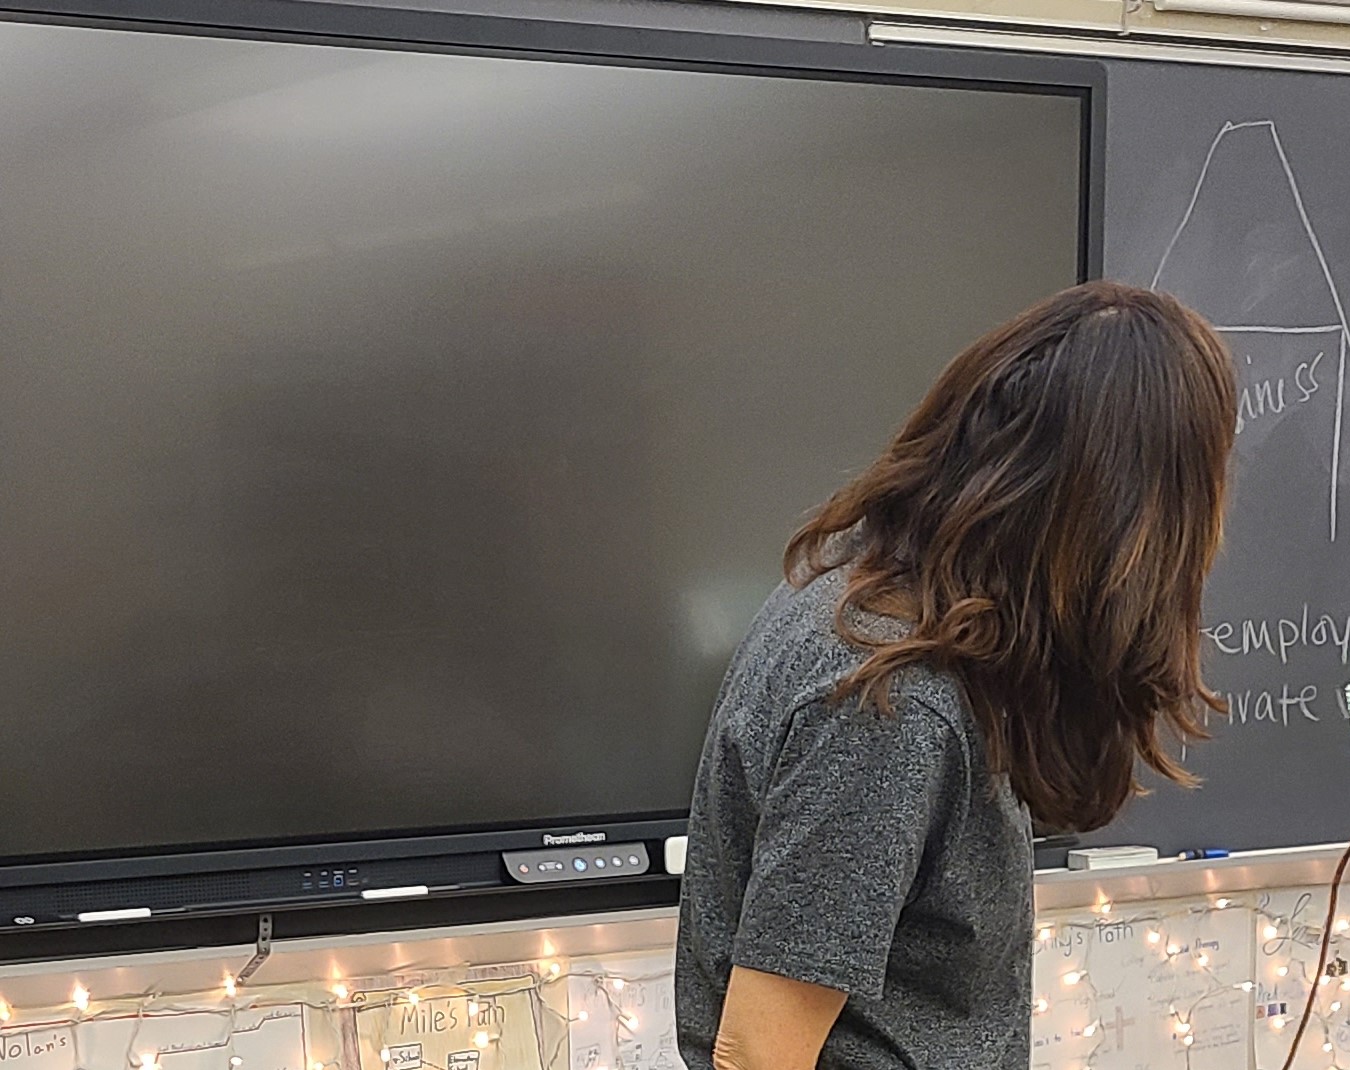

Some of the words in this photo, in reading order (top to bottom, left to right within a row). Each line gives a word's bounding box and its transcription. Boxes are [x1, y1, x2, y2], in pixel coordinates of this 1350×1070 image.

[543, 832, 606, 846] Promethean
[1099, 917, 1134, 943] Path
[401, 1000, 458, 1036] Mile's
